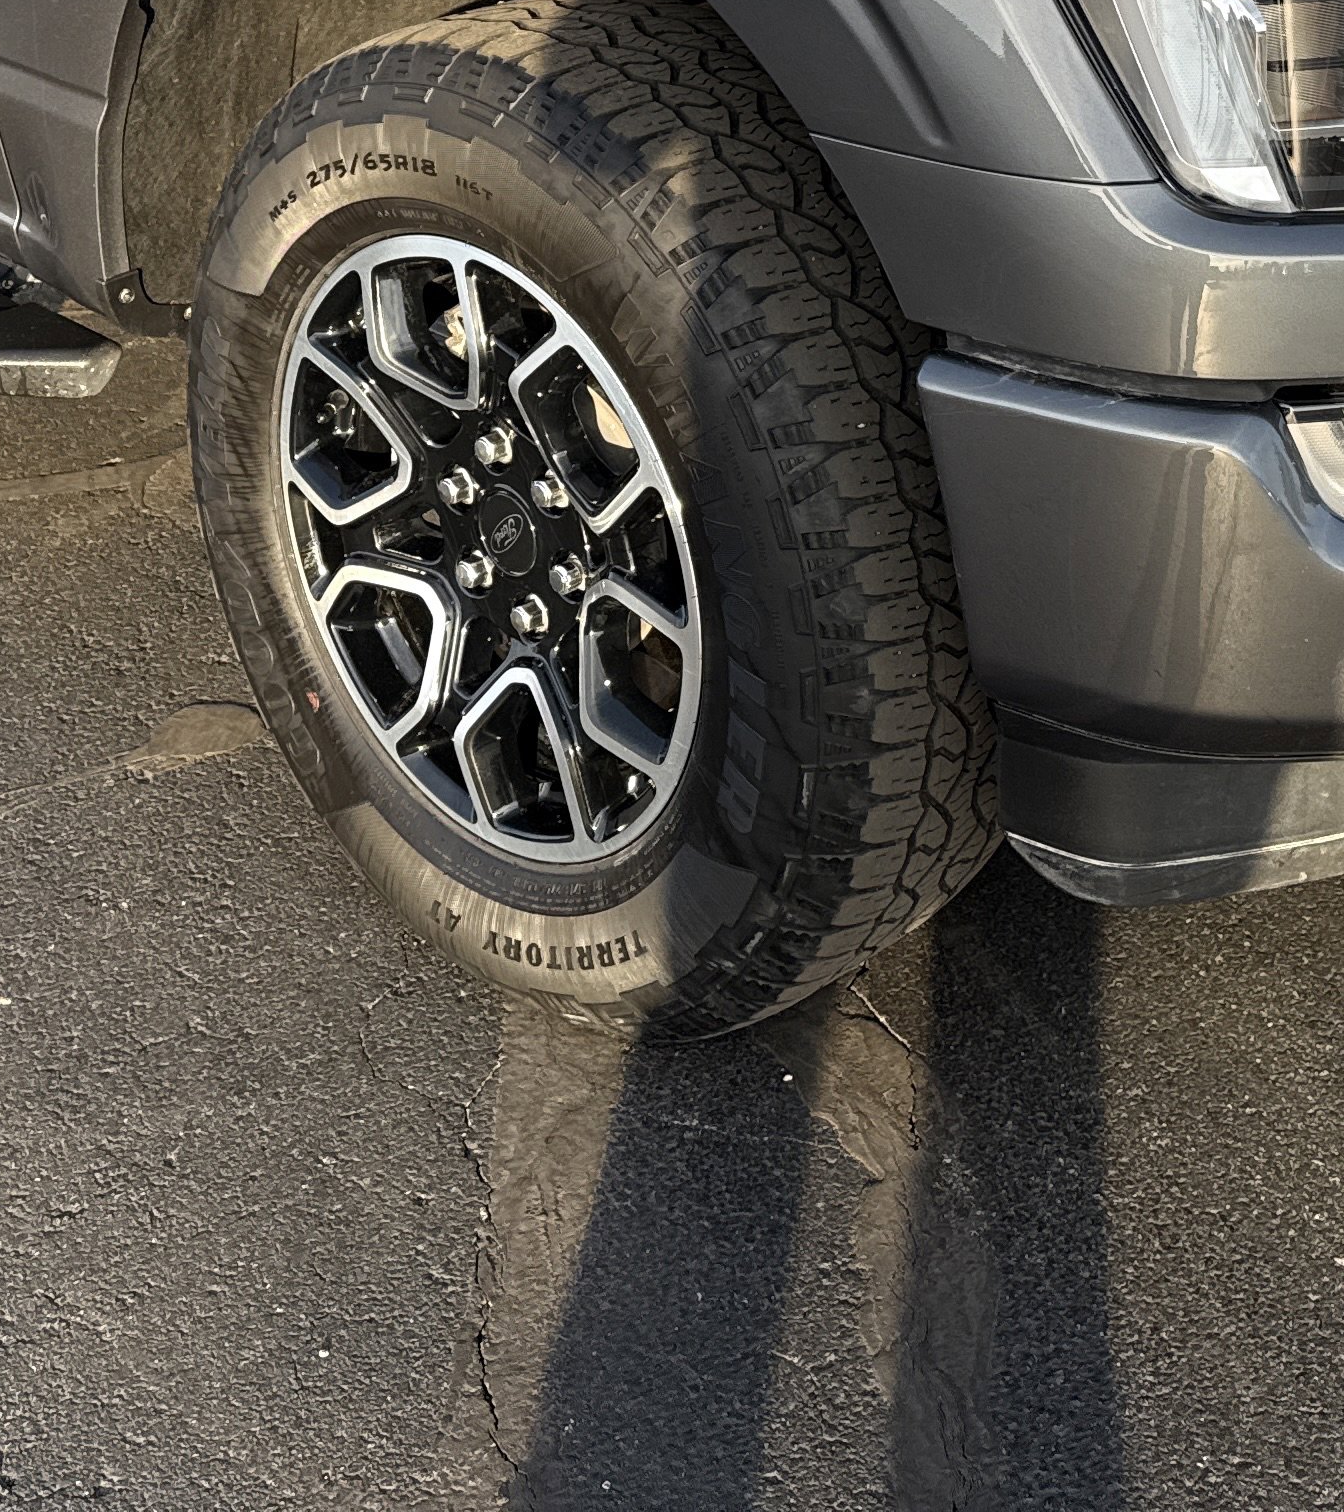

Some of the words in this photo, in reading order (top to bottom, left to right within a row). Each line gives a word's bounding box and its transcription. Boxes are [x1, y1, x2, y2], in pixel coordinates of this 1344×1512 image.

[305, 151, 438, 190] 275/65R18
[609, 285, 771, 836] WRANGLER
[424, 898, 464, 934] AT
[481, 927, 649, 971] TERRITORY
